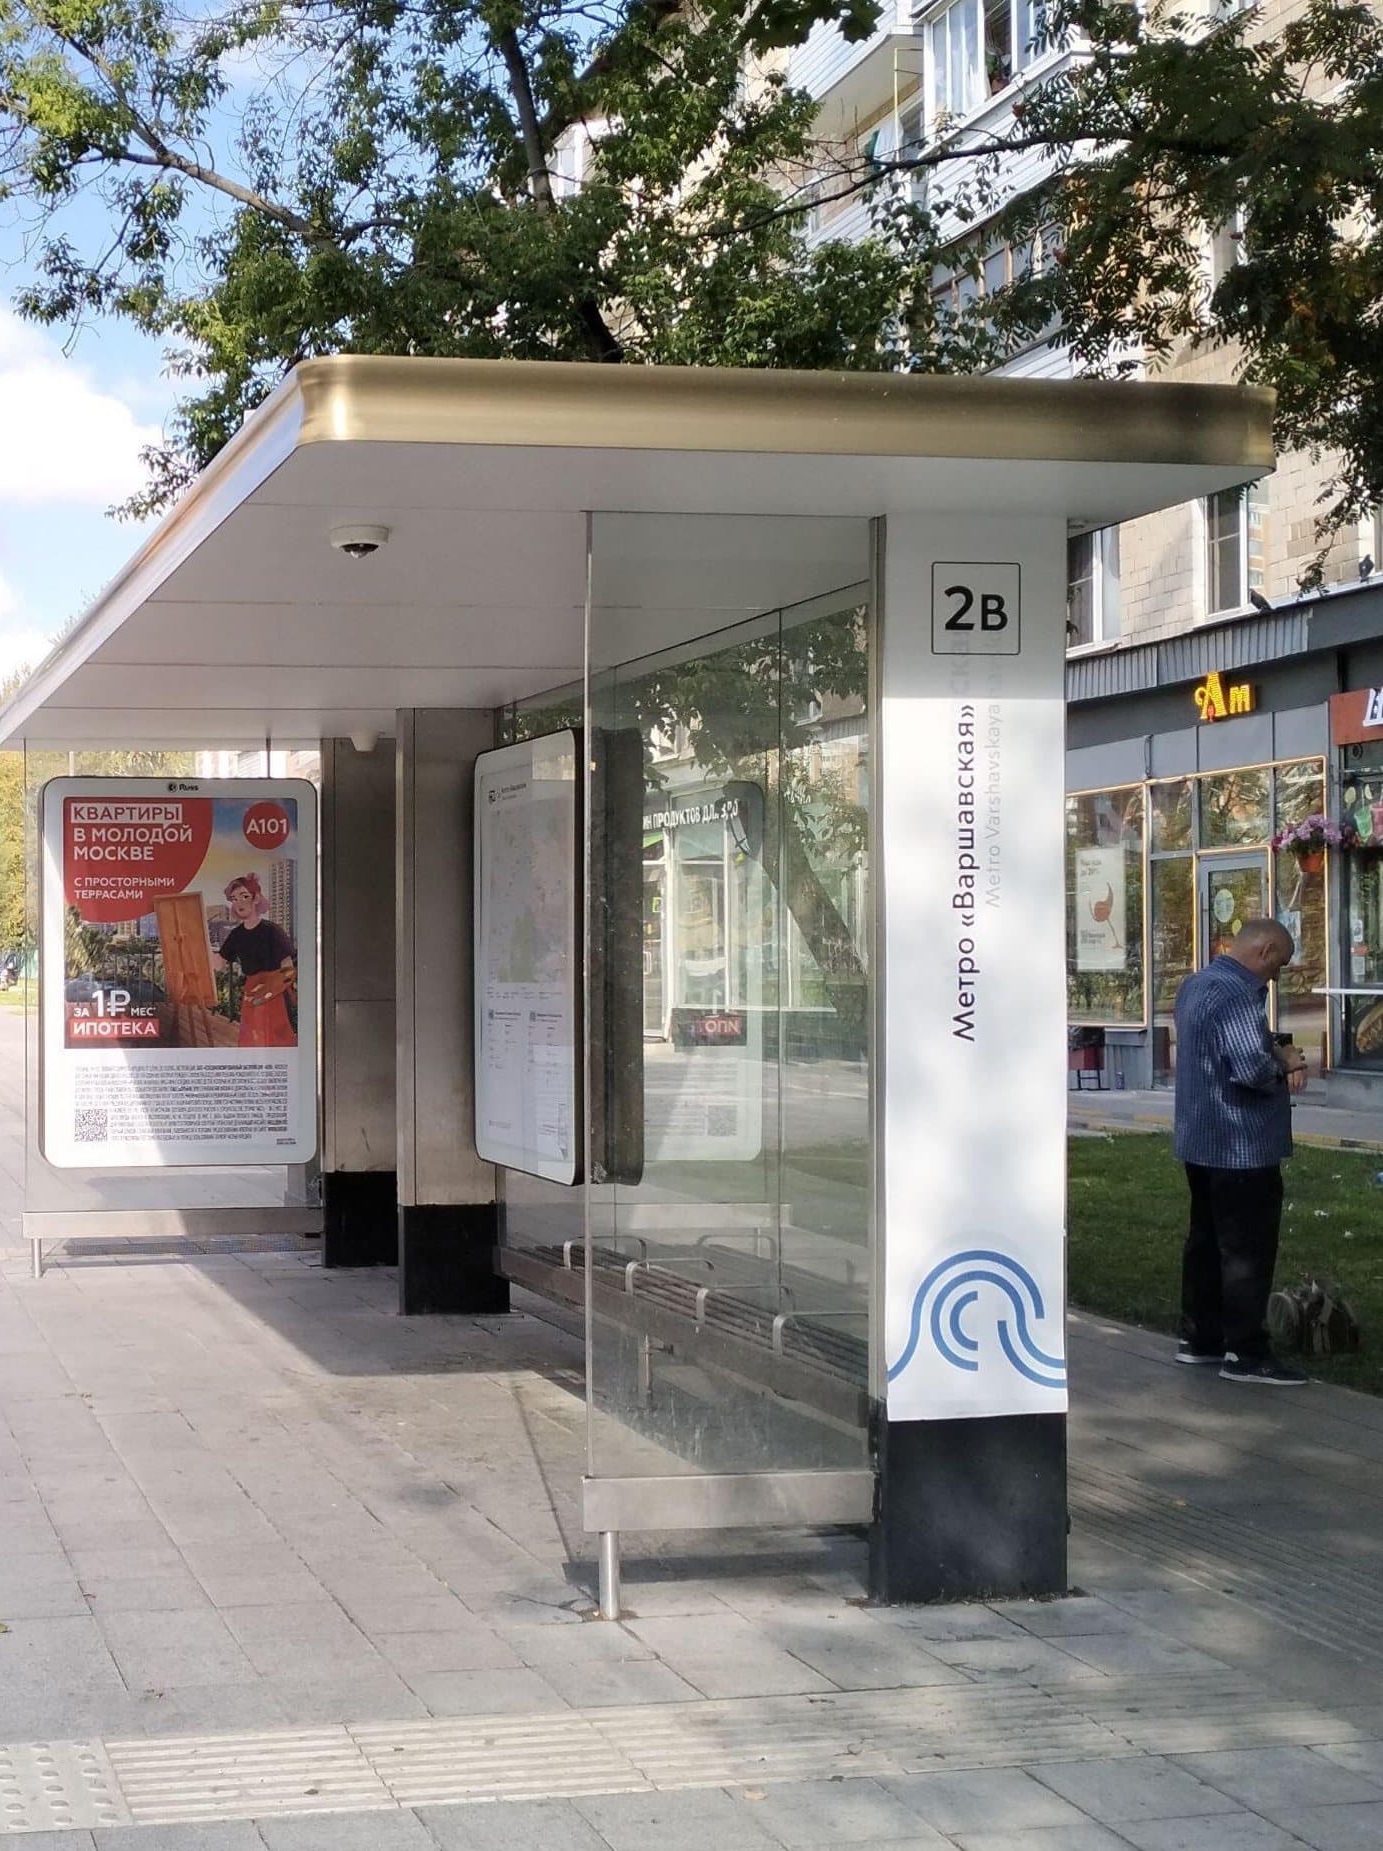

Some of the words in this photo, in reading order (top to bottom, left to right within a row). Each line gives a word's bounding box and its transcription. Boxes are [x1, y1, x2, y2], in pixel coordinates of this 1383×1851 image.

[985, 703, 1003, 839] Varshavskaya
[73, 806, 180, 821] КВАРТИРЫ
[653, 806, 701, 829] ПРОДУКТОВ
[952, 704, 980, 927] «Варшавская»
[74, 829, 87, 843] В
[92, 825, 193, 844] МОЛОДОЙ
[74, 847, 155, 862] МОСКВЕ
[74, 878, 83, 887] С
[84, 877, 175, 887] ПРОСТОРНЫМИ
[985, 845, 1001, 908] Metro
[74, 890, 144, 900] ТЕРРАСАМИ
[952, 938, 980, 1043] Метро
[74, 1007, 90, 1017] ЗА
[73, 1021, 157, 1035] ИПОТЕКА
